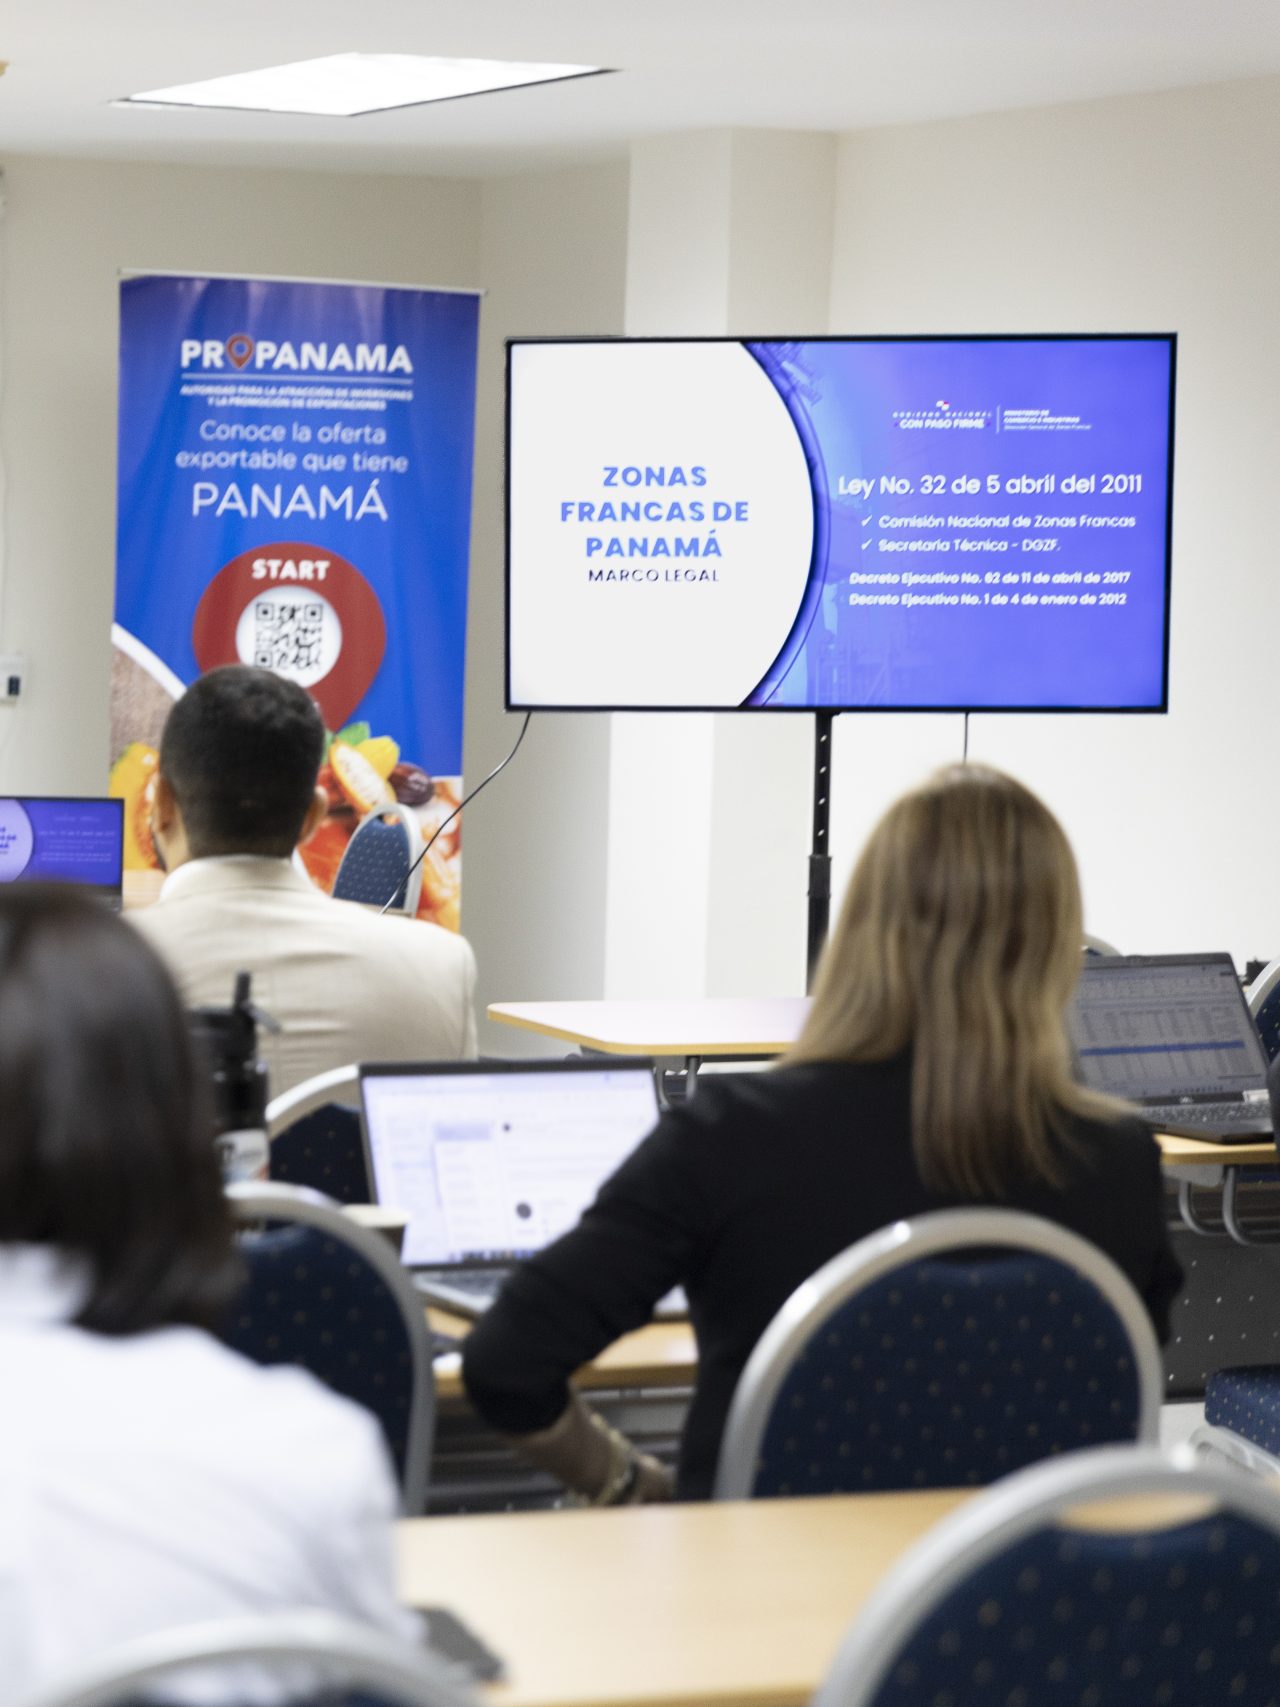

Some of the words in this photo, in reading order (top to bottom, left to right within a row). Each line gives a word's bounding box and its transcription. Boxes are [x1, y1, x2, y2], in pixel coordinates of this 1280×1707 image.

[199, 419, 286, 442] Conoce
[292, 421, 312, 443] la
[317, 421, 387, 445] oferta
[900, 419, 924, 429] CON
[175, 449, 297, 470] exportable
[302, 452, 347, 473] que
[352, 451, 409, 474] tiene
[602, 466, 707, 487] ZONAS
[838, 475, 876, 500] Ley
[880, 475, 915, 495] No.
[920, 474, 947, 495] 32
[951, 474, 981, 495] de
[986, 474, 1001, 494] 5
[1005, 473, 1056, 494] abril
[1060, 474, 1095, 494] del
[1100, 473, 1143, 494] 2011
[192, 478, 389, 521] PANAMÁ
[560, 501, 705, 522] FRANCAS
[712, 501, 749, 522] DE
[878, 514, 945, 529] Comisión
[947, 514, 1010, 528] Nacional
[1012, 515, 1032, 528] de
[1034, 514, 1077, 528] Zonas
[1079, 514, 1137, 528] Francas
[586, 529, 723, 558] PANAMÁ
[953, 537, 1009, 552] Técnica
[251, 558, 331, 580] START
[588, 569, 659, 582] MARCO
[665, 569, 720, 582] LEGAL
[849, 572, 900, 585] Decreto
[901, 571, 960, 587] Ejecutivo
[961, 572, 982, 585] No.
[1002, 571, 1019, 584] de
[1021, 571, 1032, 584] 11
[1033, 571, 1050, 584] de
[1051, 571, 1082, 584] abril
[1083, 571, 1100, 584] de
[1102, 571, 1131, 584] 2017
[849, 593, 900, 606] Decreto
[901, 592, 960, 608] Ejecutivo
[961, 593, 982, 605] No.
[984, 592, 990, 605] 1
[991, 592, 1009, 605] de
[1010, 592, 1019, 605] 4
[1021, 592, 1039, 605] de
[1040, 594, 1078, 605] enero
[1080, 592, 1097, 605] de
[1098, 592, 1127, 605] 2012
